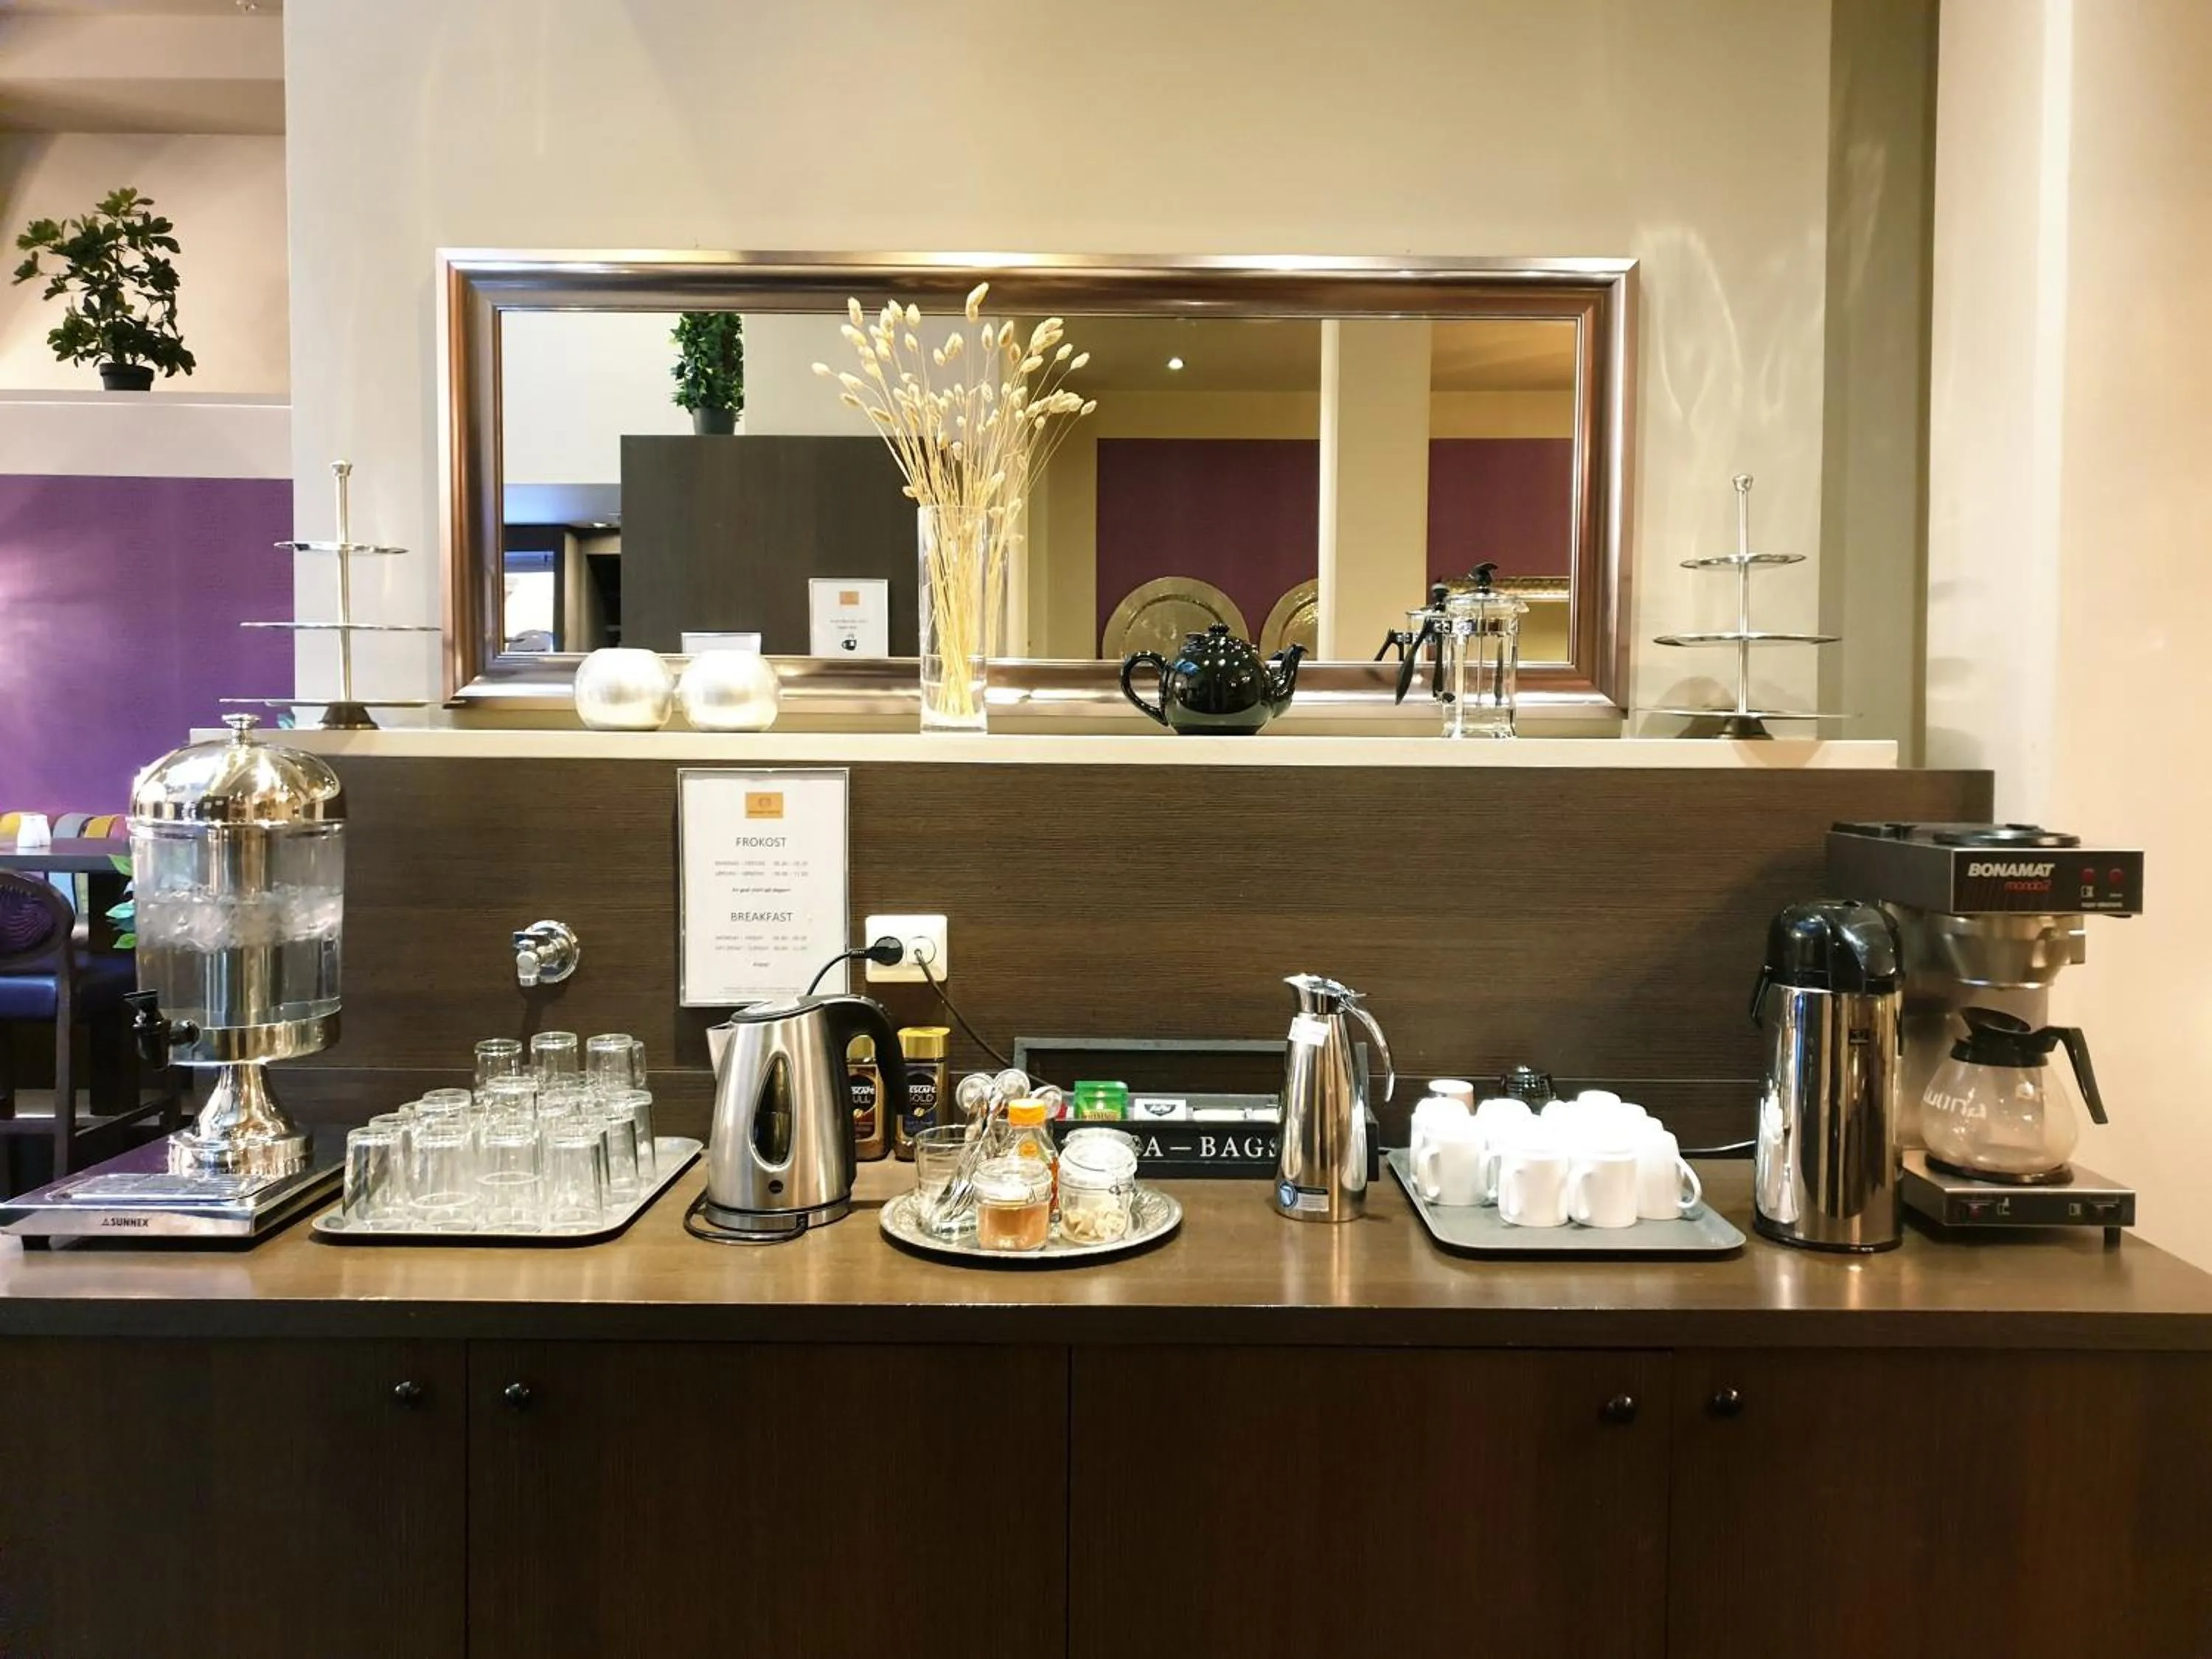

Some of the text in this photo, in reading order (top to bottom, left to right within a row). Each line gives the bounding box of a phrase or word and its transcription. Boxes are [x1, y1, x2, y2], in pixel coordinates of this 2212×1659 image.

[736, 837, 787, 847] FROKOST
[1967, 863, 2055, 877] BONAMAT
[731, 911, 793, 922] BREAKFAST
[852, 1095, 871, 1104] ULL
